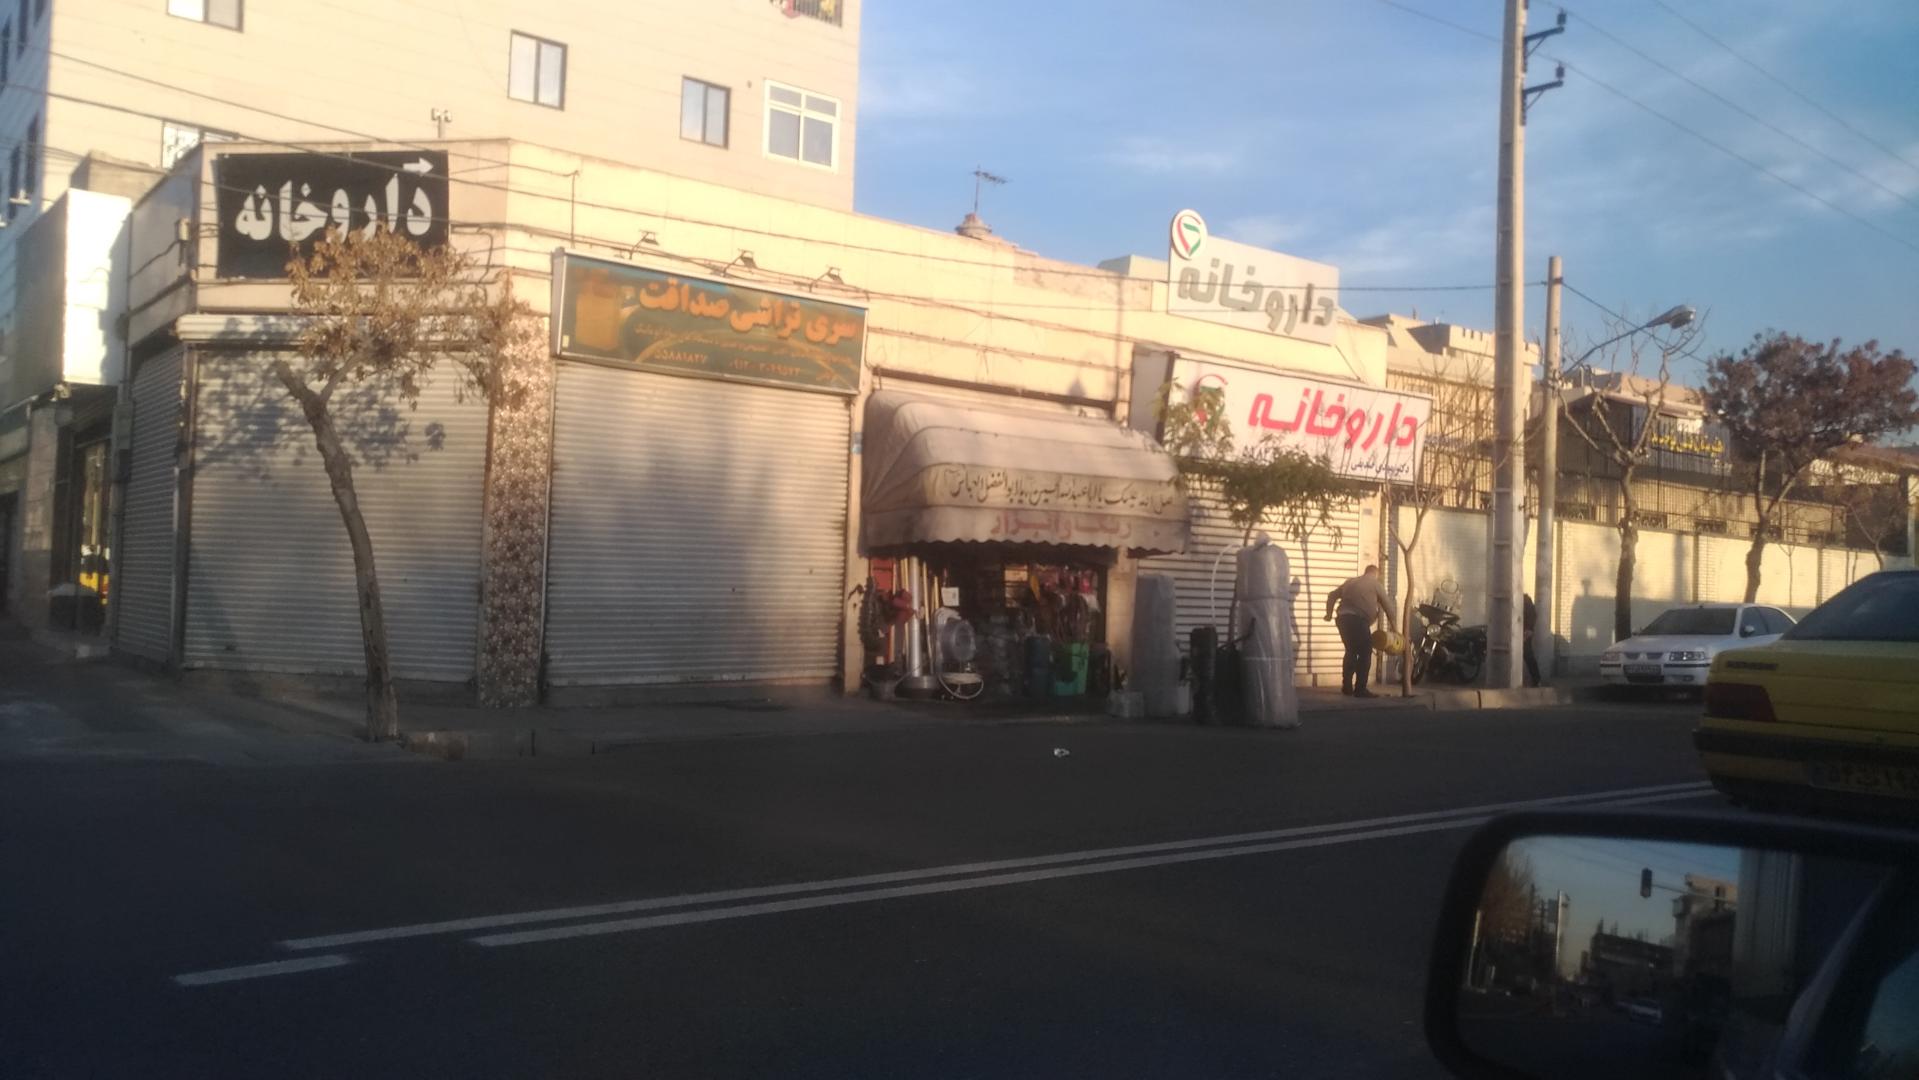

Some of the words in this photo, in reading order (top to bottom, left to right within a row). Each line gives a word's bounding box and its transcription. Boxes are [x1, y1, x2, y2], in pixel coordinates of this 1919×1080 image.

[235, 173, 432, 243] داروخانه
[639, 278, 730, 318] صداقت
[730, 296, 801, 338] تراشی
[1176, 258, 1336, 335] داروخانه
[805, 314, 860, 345] سری
[1247, 387, 1419, 451] داروخانه
